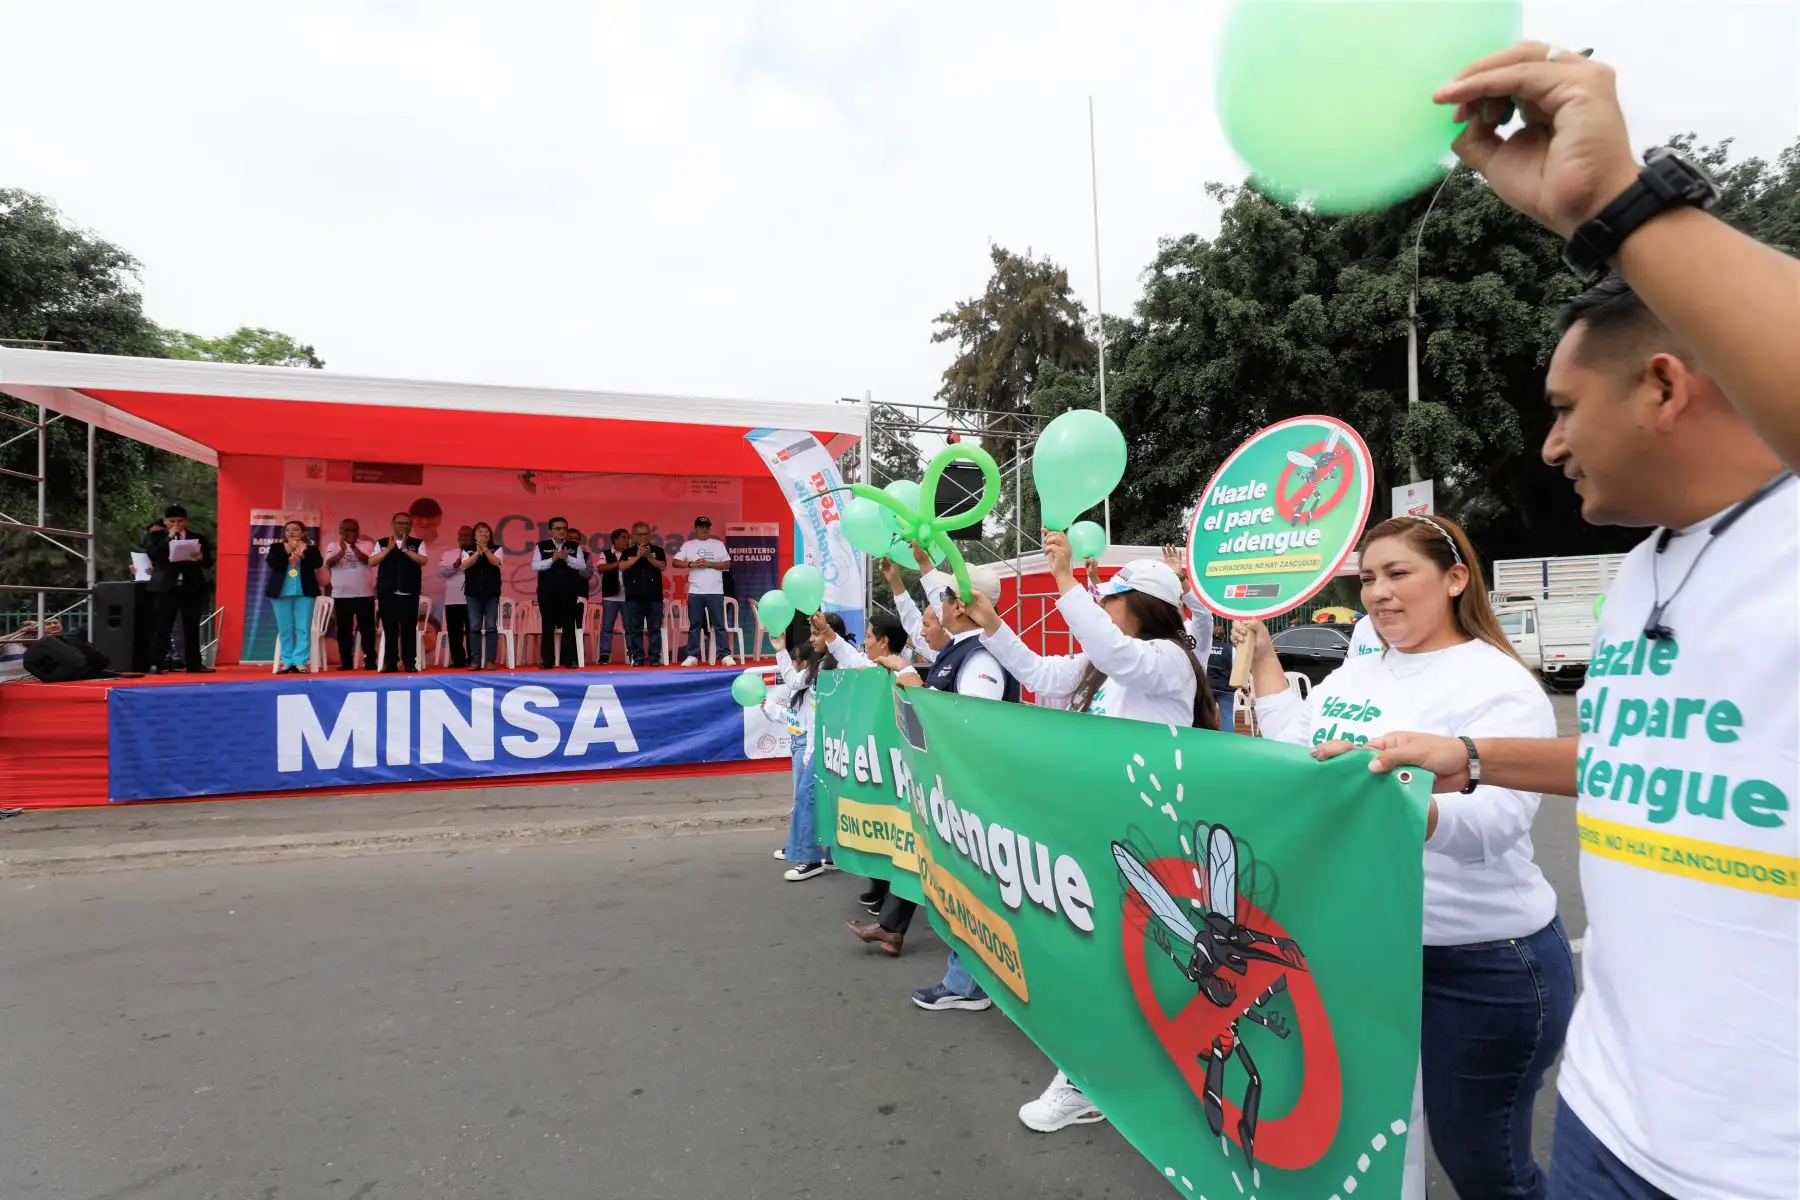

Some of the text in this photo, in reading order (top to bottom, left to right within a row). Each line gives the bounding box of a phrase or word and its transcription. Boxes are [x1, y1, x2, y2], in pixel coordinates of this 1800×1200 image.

[1210, 479, 1268, 506] Hazle
[1203, 506, 1274, 533] el pare
[733, 554, 772, 562] DE SALUD
[1218, 528, 1321, 555] al dengue
[1588, 631, 1680, 678] azle
[1321, 695, 1383, 723] Hazle
[1579, 686, 1744, 747] el pare
[276, 684, 640, 773] MINSA
[854, 734, 883, 783] el
[929, 773, 1095, 932] dengue
